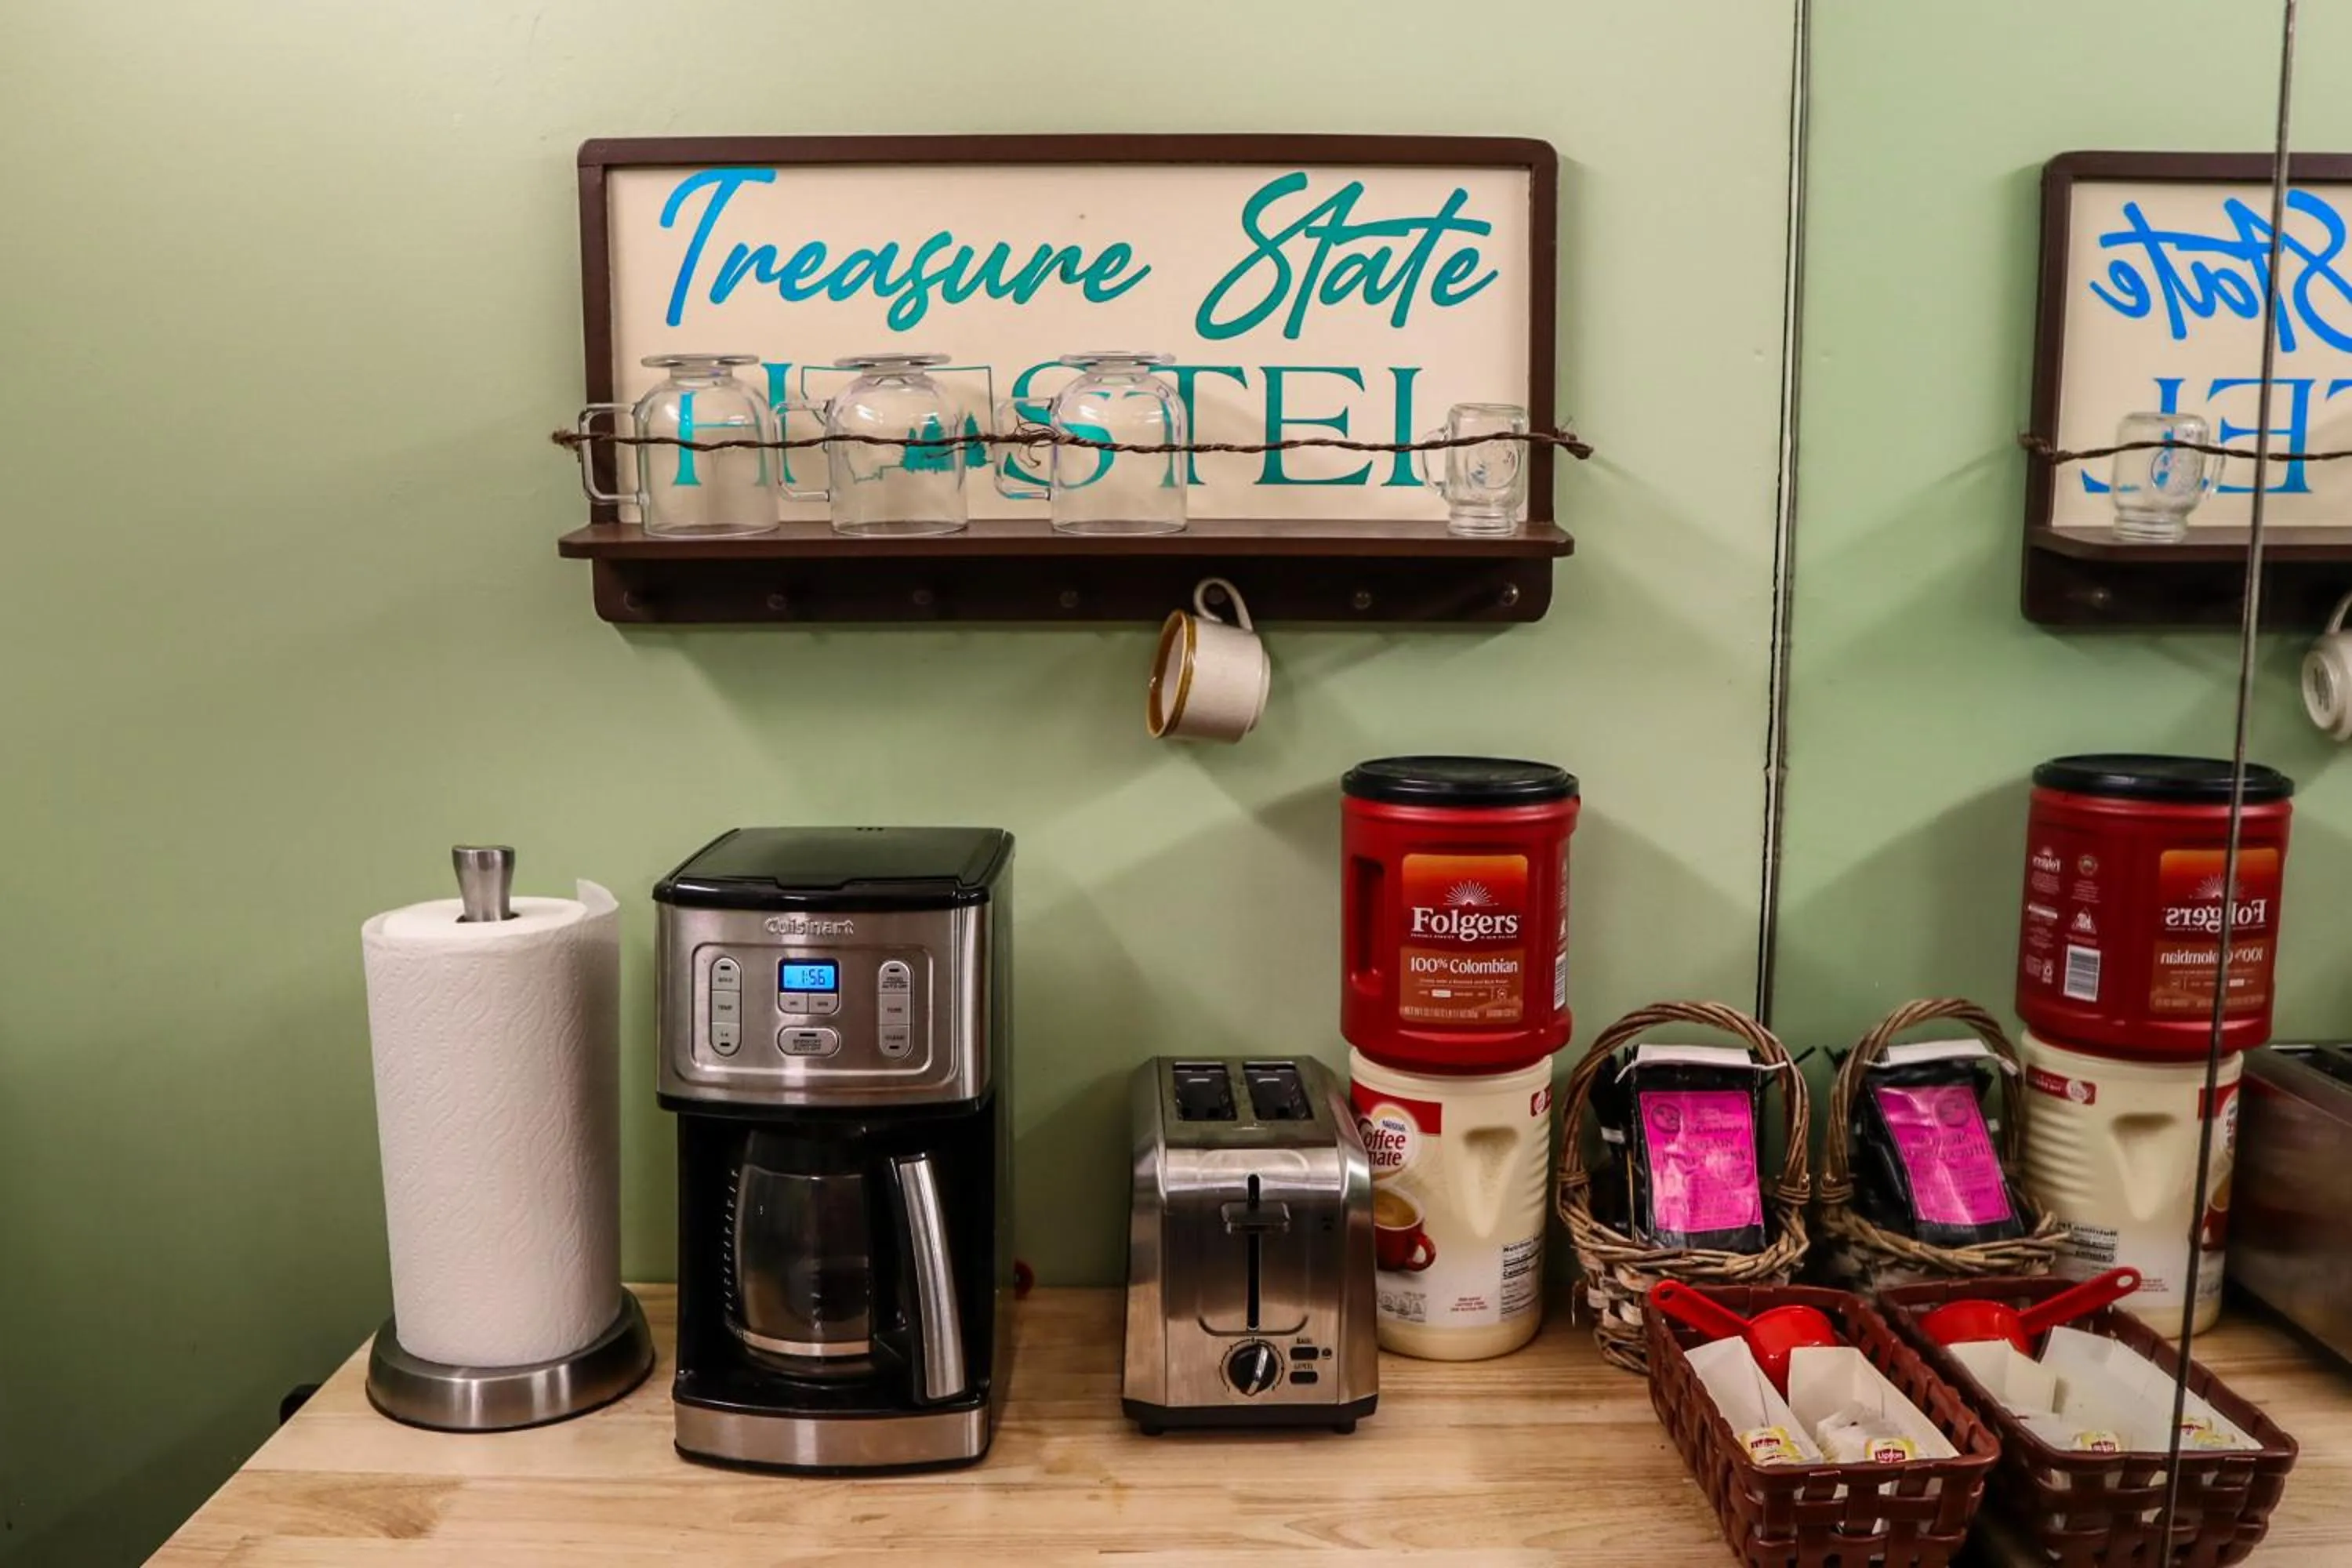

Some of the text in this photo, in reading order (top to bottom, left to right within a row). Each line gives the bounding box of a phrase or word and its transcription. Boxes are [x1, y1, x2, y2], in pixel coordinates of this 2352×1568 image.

[659, 167, 1498, 340] Treasure State
[764, 916, 855, 936] Cuisinart
[1411, 906, 1518, 942] Folgers
[1410, 956, 1518, 975] 100% Colombian
[800, 969, 826, 986] 1:56
